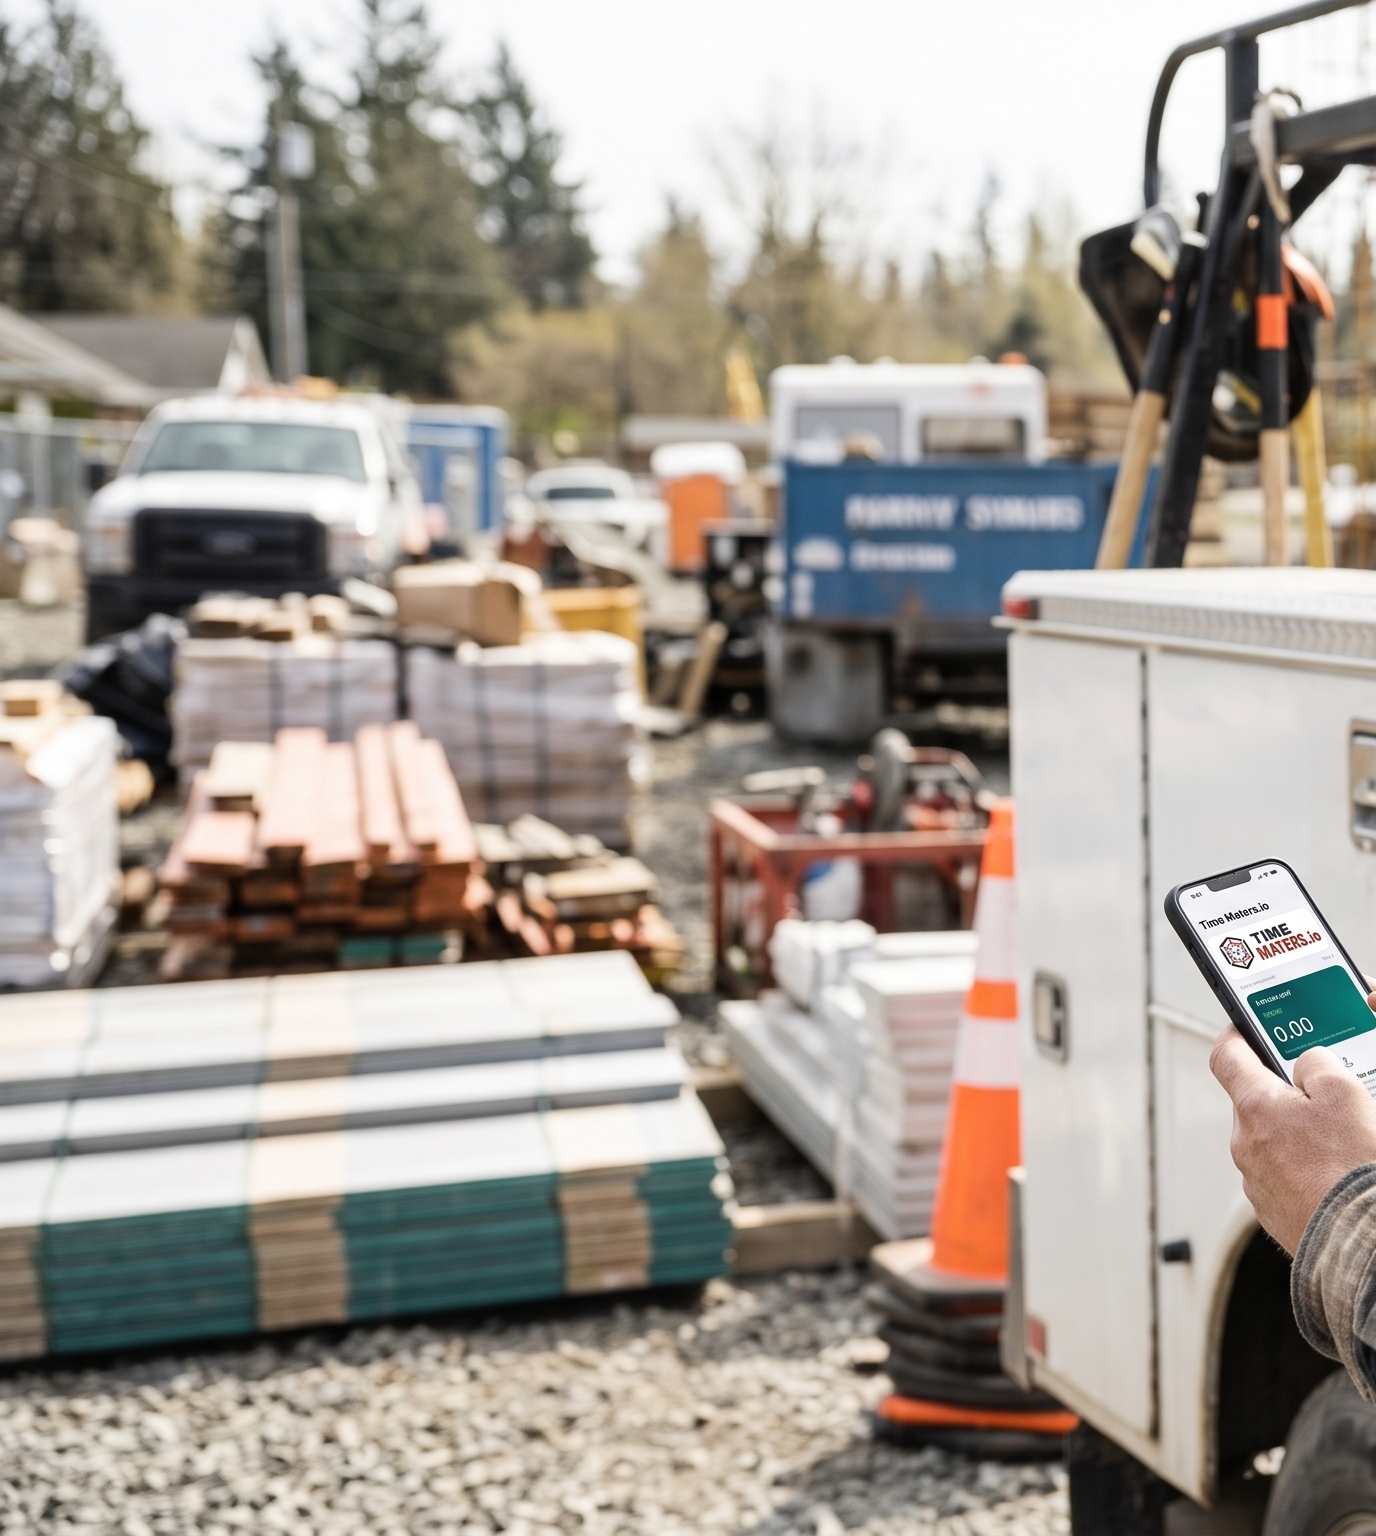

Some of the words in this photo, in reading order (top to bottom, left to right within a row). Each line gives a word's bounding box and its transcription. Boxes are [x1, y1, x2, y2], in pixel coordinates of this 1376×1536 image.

[1199, 916, 1225, 930] Time
[1224, 902, 1270, 923] Maters.io
[1250, 922, 1292, 945] TIME
[1255, 930, 1322, 961] MATERS.io
[1273, 1016, 1314, 1043] 0.00
